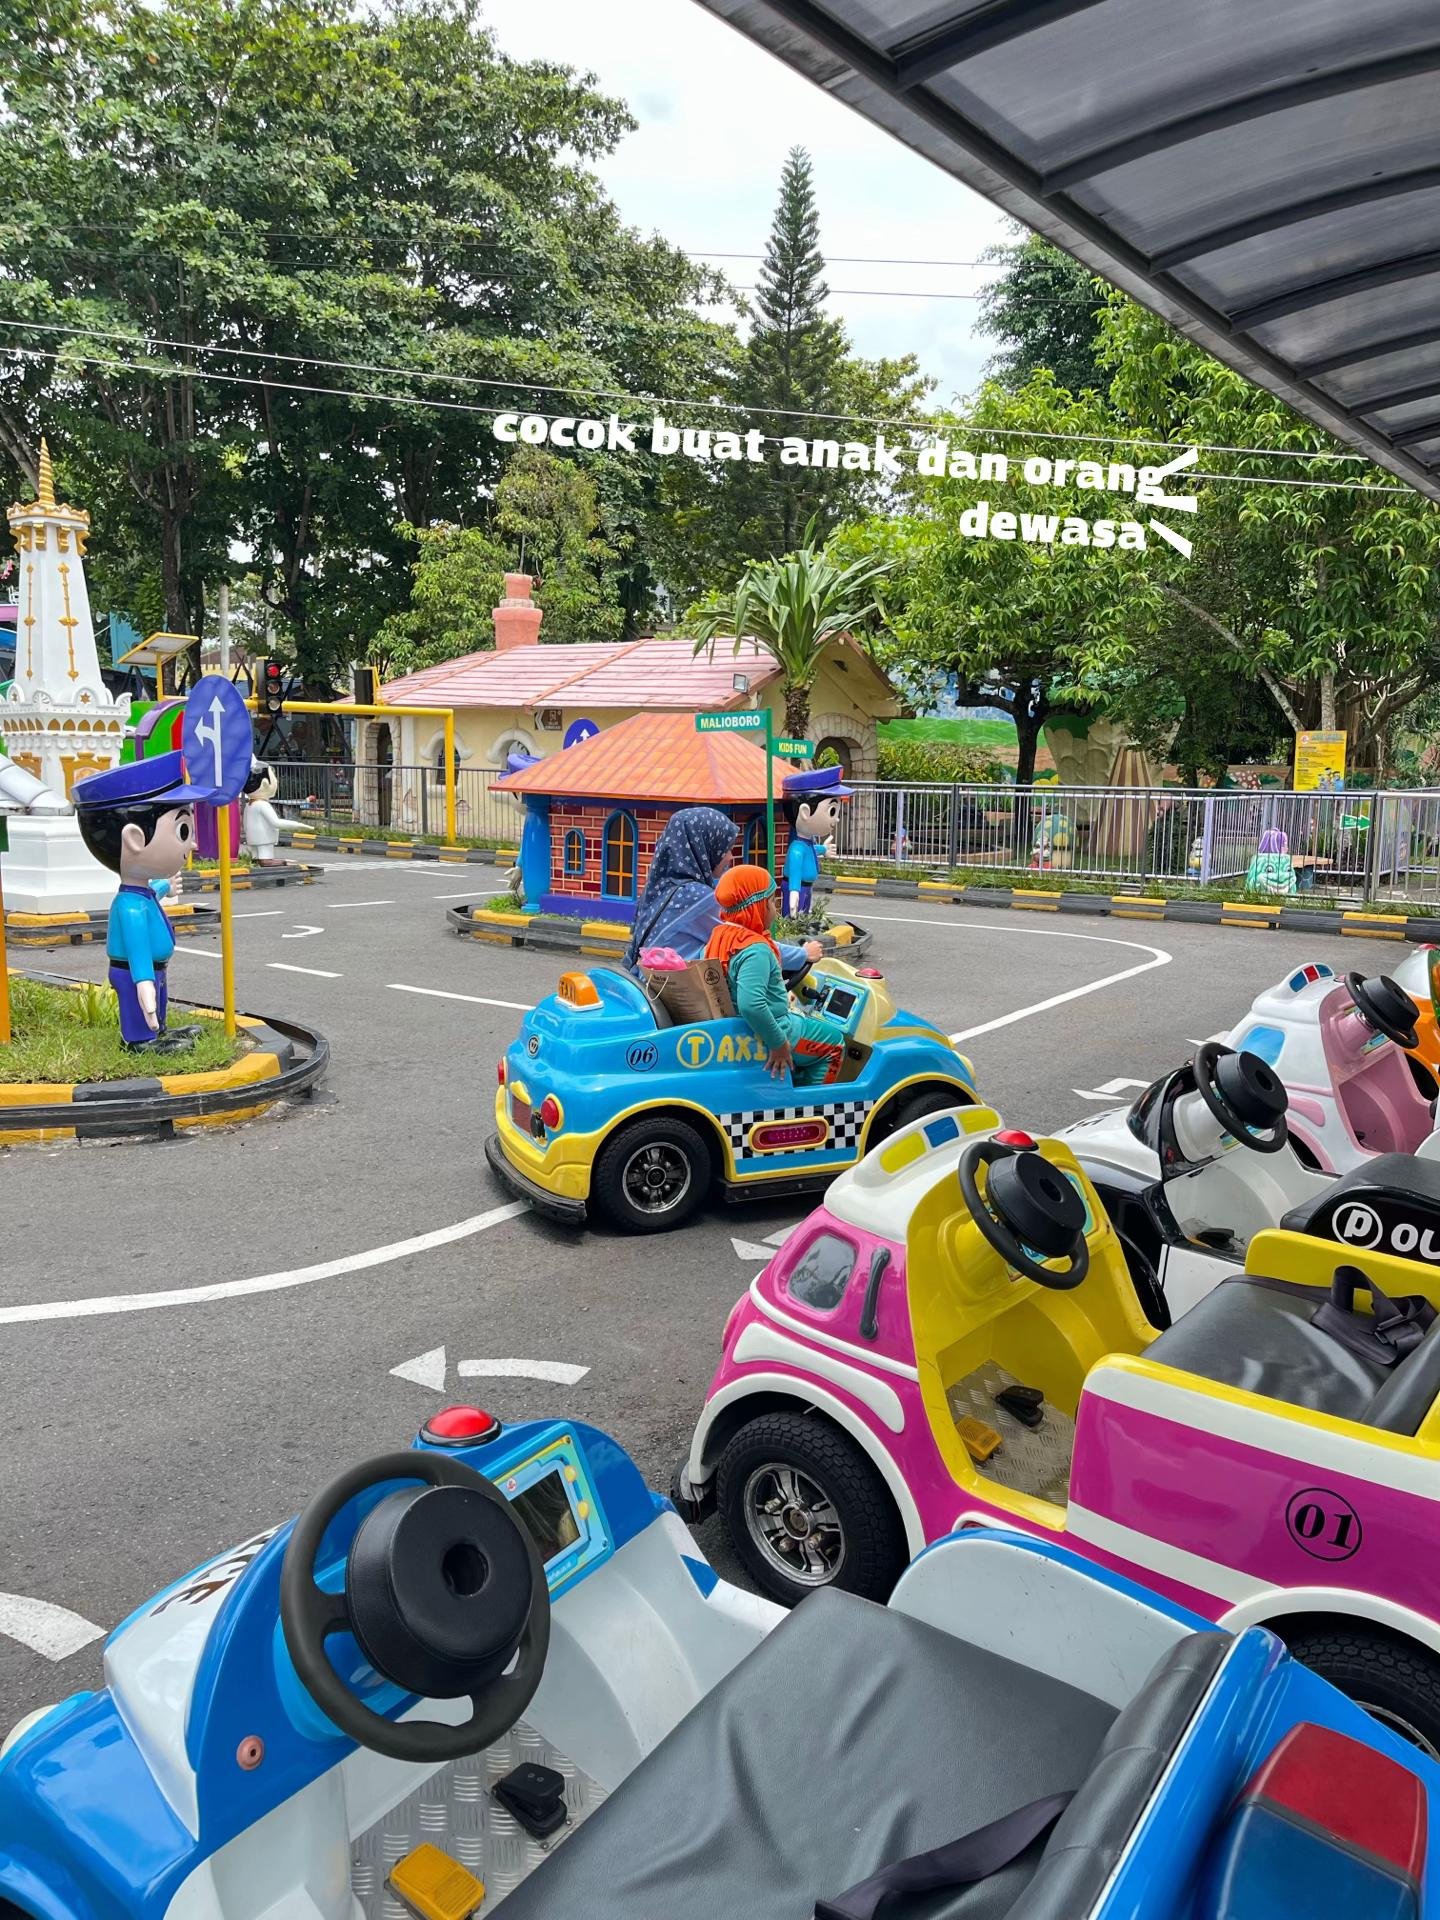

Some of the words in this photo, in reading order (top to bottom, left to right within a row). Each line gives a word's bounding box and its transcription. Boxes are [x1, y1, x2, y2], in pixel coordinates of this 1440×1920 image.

[700, 714, 761, 729] MALIOBORO
[778, 742, 794, 753] KIDS
[794, 743, 808, 755] FUN
[629, 1043, 657, 1066] 06
[1294, 1503, 1353, 1550] 01
